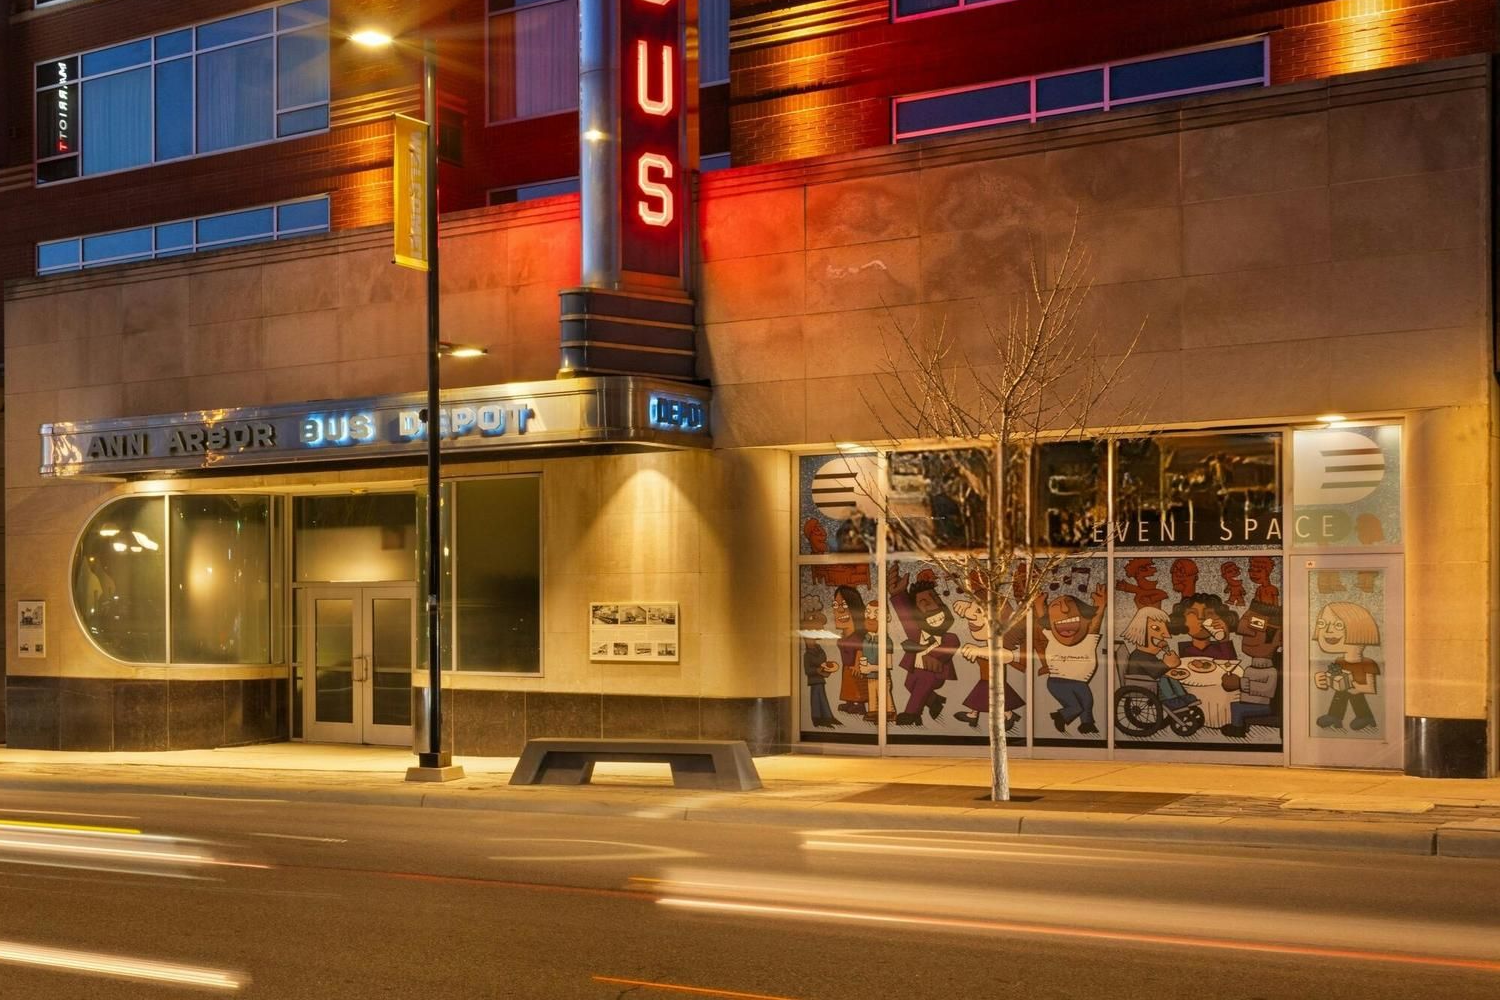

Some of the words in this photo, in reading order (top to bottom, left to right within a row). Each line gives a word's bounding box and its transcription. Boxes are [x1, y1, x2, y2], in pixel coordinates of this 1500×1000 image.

[86, 431, 148, 459] ANN
[168, 422, 276, 455] ARBOR
[300, 413, 375, 444] BUS
[1219, 515, 1335, 541] SPACE
